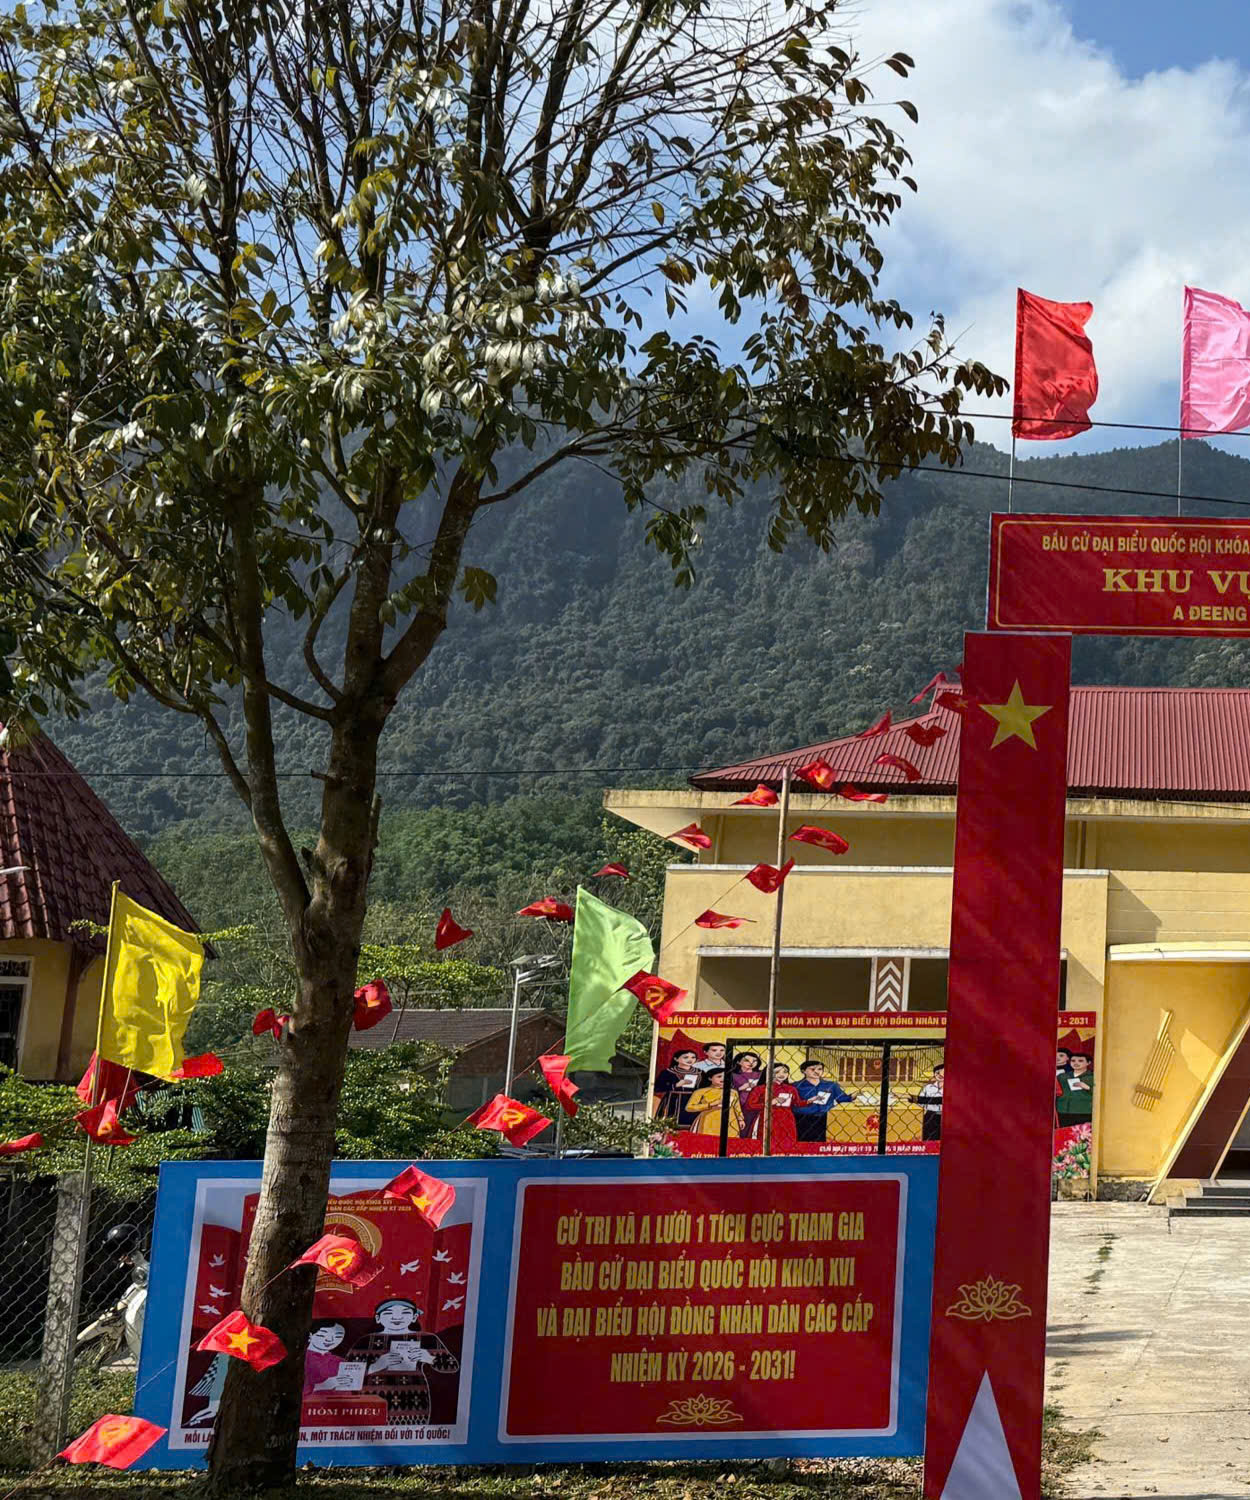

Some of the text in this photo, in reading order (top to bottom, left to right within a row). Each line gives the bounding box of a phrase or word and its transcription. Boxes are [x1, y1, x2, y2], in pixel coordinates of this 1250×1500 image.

[1042, 530, 1068, 550] BẦU
[1072, 531, 1090, 551] CỬ
[1092, 537, 1113, 556] ĐẠI
[1118, 530, 1147, 551] BIỂU
[1151, 532, 1186, 553] QUỐC
[1189, 536, 1211, 558] HỘI
[1215, 535, 1249, 555] KHÓA
[1102, 568, 1194, 593] KHU
[1173, 606, 1184, 620] A
[1189, 606, 1248, 622] ĐEENG
[1069, 1017, 1088, 1025] 2031
[556, 1208, 864, 1248] CỬ TRI XÃ A LƯỚI 1 TÍCH CỰC THAM GIA
[560, 1249, 855, 1295] BẦU CỬ ĐẠI BIỂU QUỐC HỘI KHÓA XVI
[536, 1293, 874, 1342] VÀ ĐẠI BIỂU HỘI ĐỒNG NHÂN DÂN CÁC CẤP
[611, 1347, 661, 1387] NHIỆM
[667, 1346, 687, 1382] KỲ
[692, 1351, 735, 1380] 2026
[749, 1349, 796, 1380] 2031!
[311, 1430, 328, 1443] MỘT
[330, 1431, 354, 1441] TRÁCH
[357, 1429, 382, 1443] NHIỆM
[385, 1428, 398, 1440] ĐỐI
[401, 1428, 412, 1439] VỚI
[415, 1426, 426, 1439] TỔ
